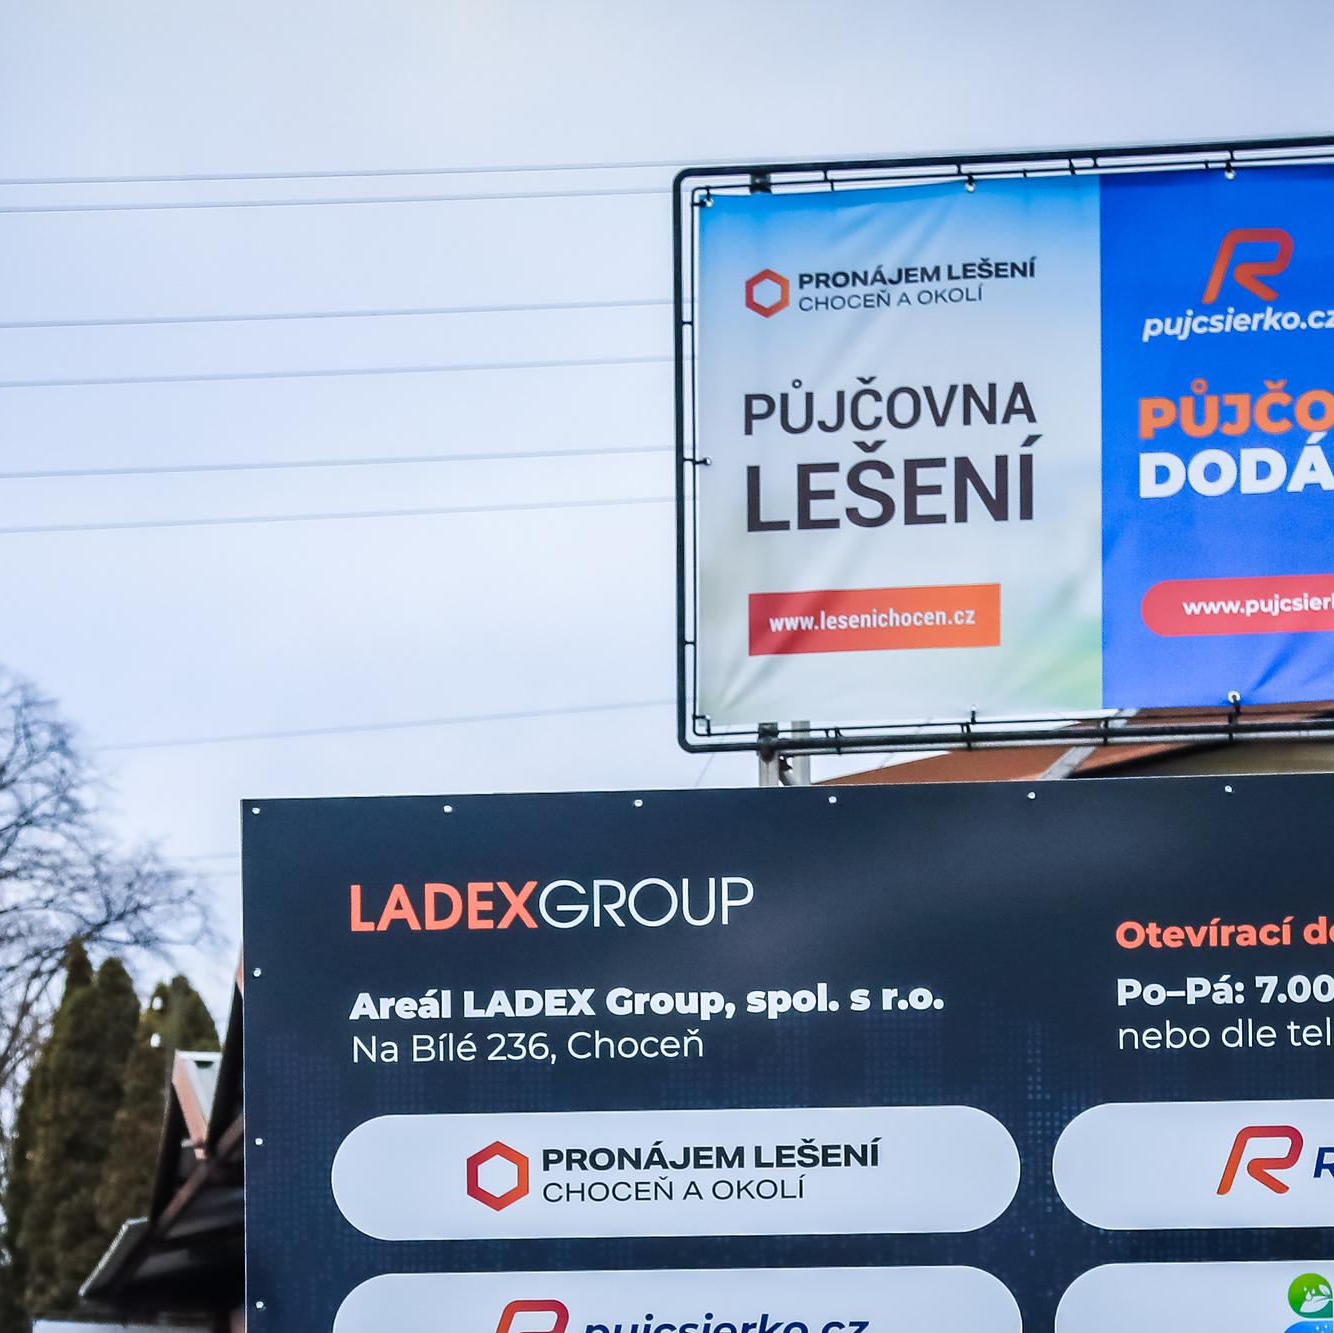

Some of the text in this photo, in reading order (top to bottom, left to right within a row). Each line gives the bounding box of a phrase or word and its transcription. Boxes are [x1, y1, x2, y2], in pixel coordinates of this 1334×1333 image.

[798, 256, 1036, 291] PRONÁJEM LEŠENÍ
[799, 286, 981, 311] CHOCEŇ A OKOLÍ
[745, 376, 1036, 435] PŮJČOVNA
[747, 434, 1042, 532] LEŠENÍ
[768, 606, 976, 633] www.lesenichocen.cz
[351, 877, 753, 931] LADEXGROUP
[1116, 916, 1294, 949] Otevírací
[349, 983, 944, 1020] Areál LADEX Group, spol. s r.o.
[354, 1029, 703, 1064] Na Bílé 236, Choceň
[1119, 1020, 1210, 1049] nebo
[1222, 1019, 1276, 1047] dle
[543, 1137, 881, 1171] PRONÁJEM LEŠENÍ
[543, 1174, 805, 1202] CHOCEŇ A OKOLÍ
